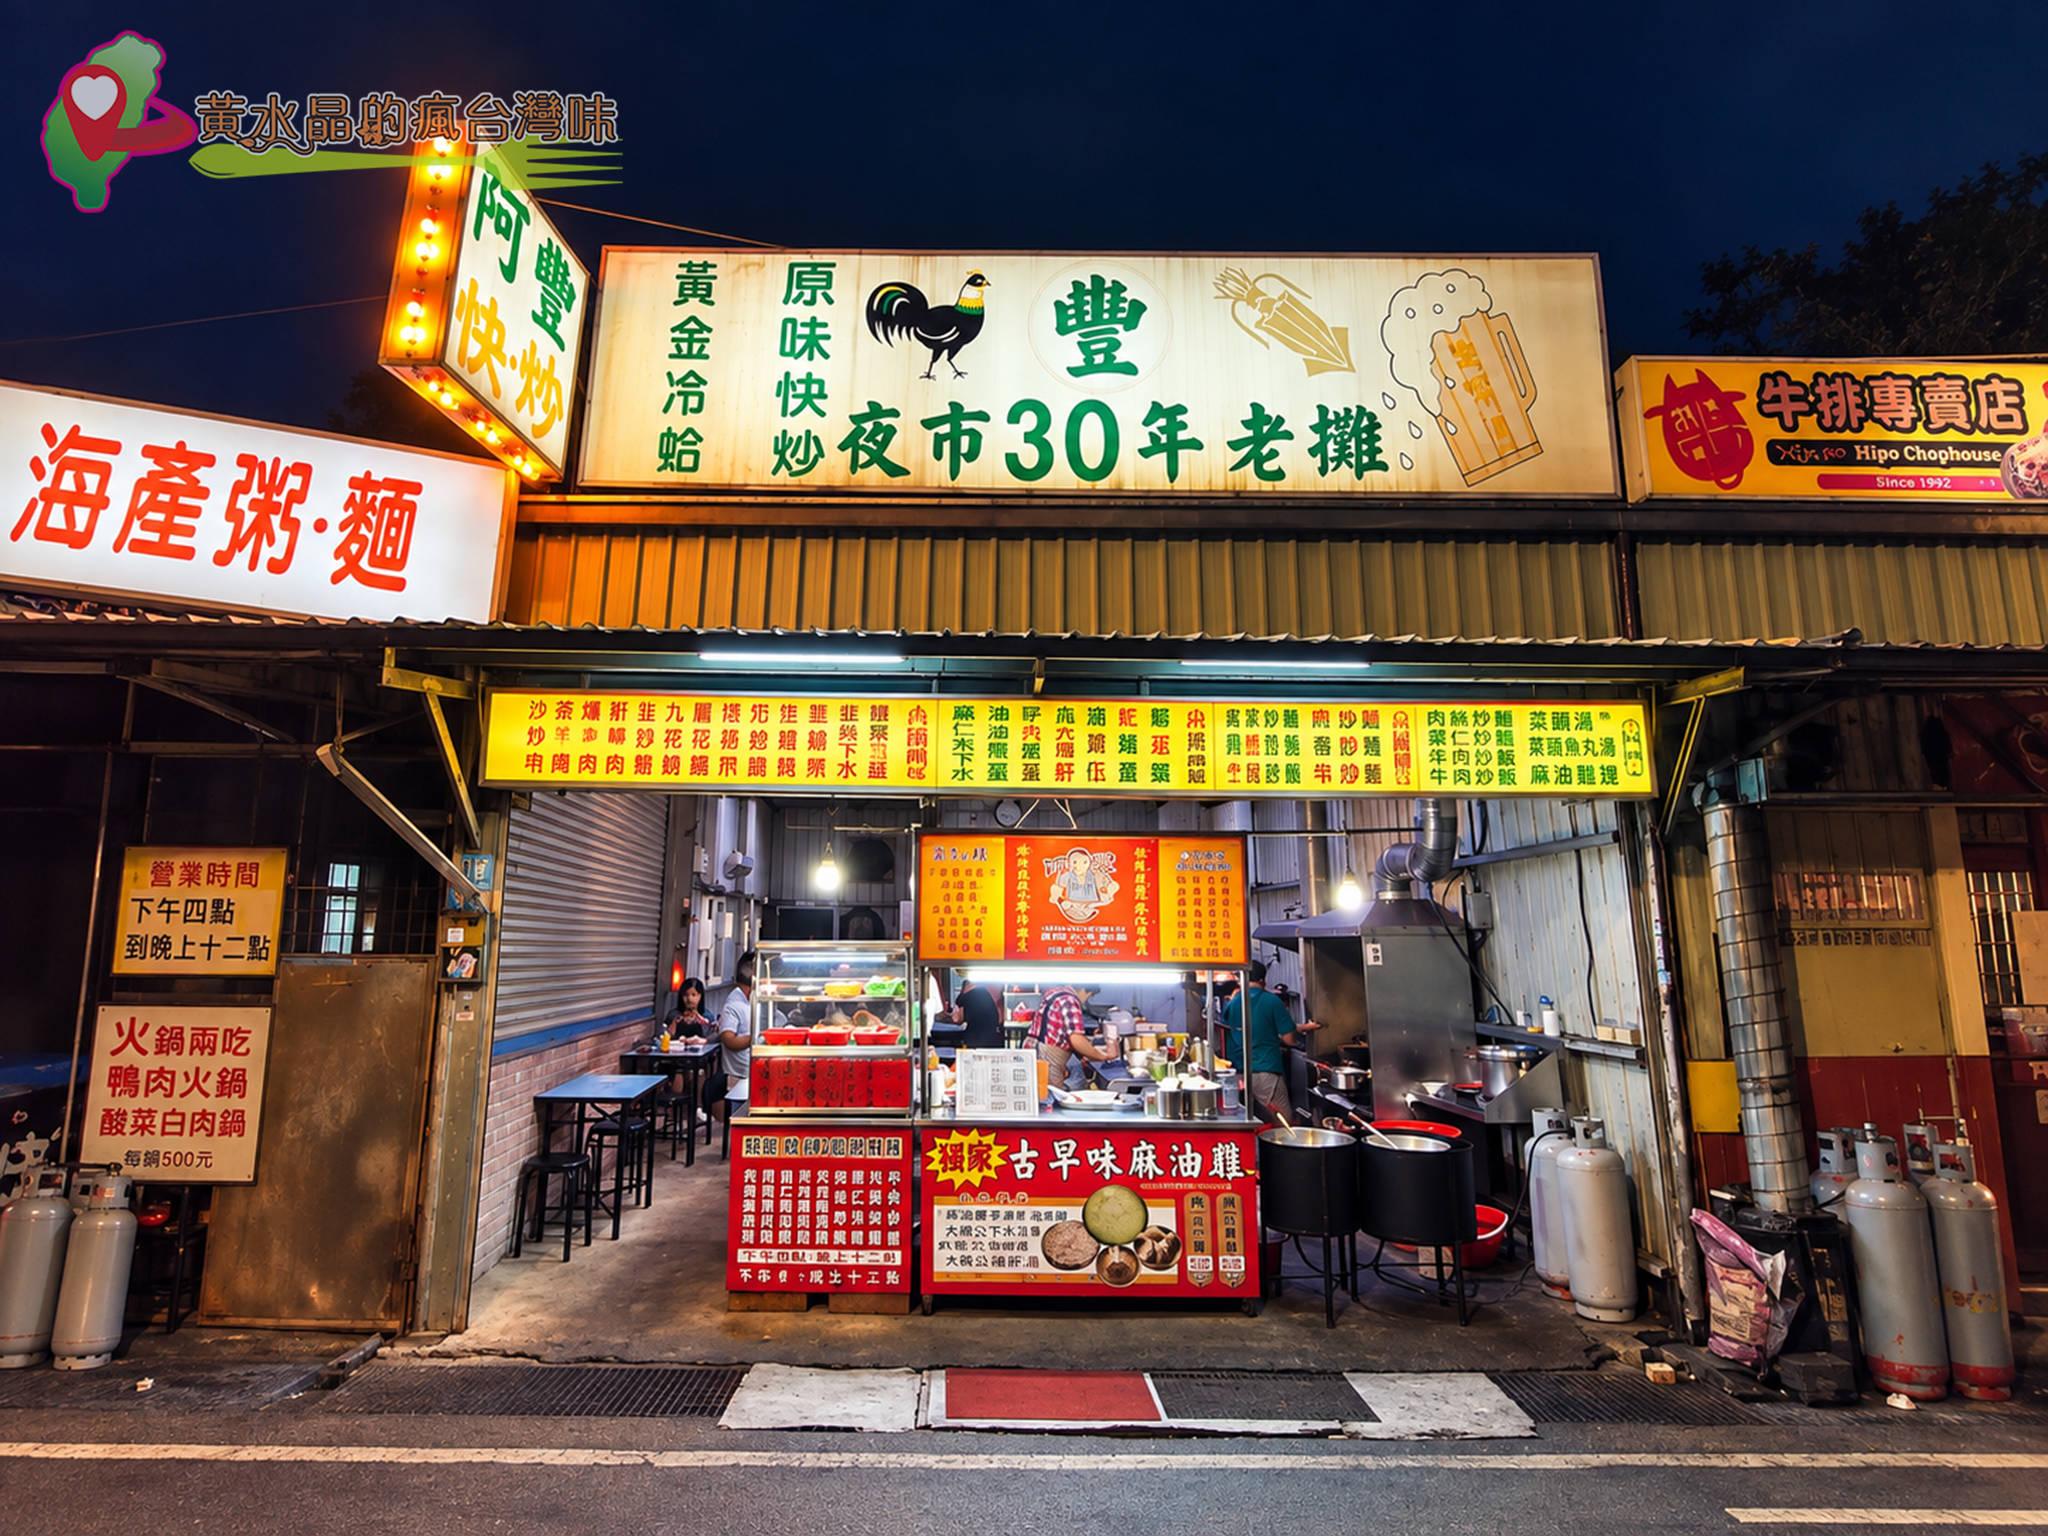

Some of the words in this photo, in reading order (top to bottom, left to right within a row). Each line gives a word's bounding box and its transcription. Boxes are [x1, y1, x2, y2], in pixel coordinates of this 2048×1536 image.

[474, 158, 577, 352] 阿豐
[1053, 274, 1148, 378] 豐
[656, 260, 718, 474] 黃金冷蛤
[771, 261, 838, 478] 原味快炒
[1758, 371, 2028, 433] 牛排專賣店
[837, 398, 1390, 485] 夜市30年老攤
[1854, 444, 1900, 465] Hipo
[1902, 445, 2003, 465] Chophouse
[1876, 476, 1916, 489] Since
[1919, 476, 1952, 489] 1992
[150, 861, 260, 888] 營業時間
[131, 897, 235, 925] 下午四點
[124, 934, 271, 962] 到晚上十二點
[109, 1016, 252, 1058] 火鍋兩吃
[107, 1064, 248, 1099] 鴨肉火鍋
[99, 1107, 246, 1138] 酸菜白肉鍋
[938, 1140, 993, 1173] 獨家
